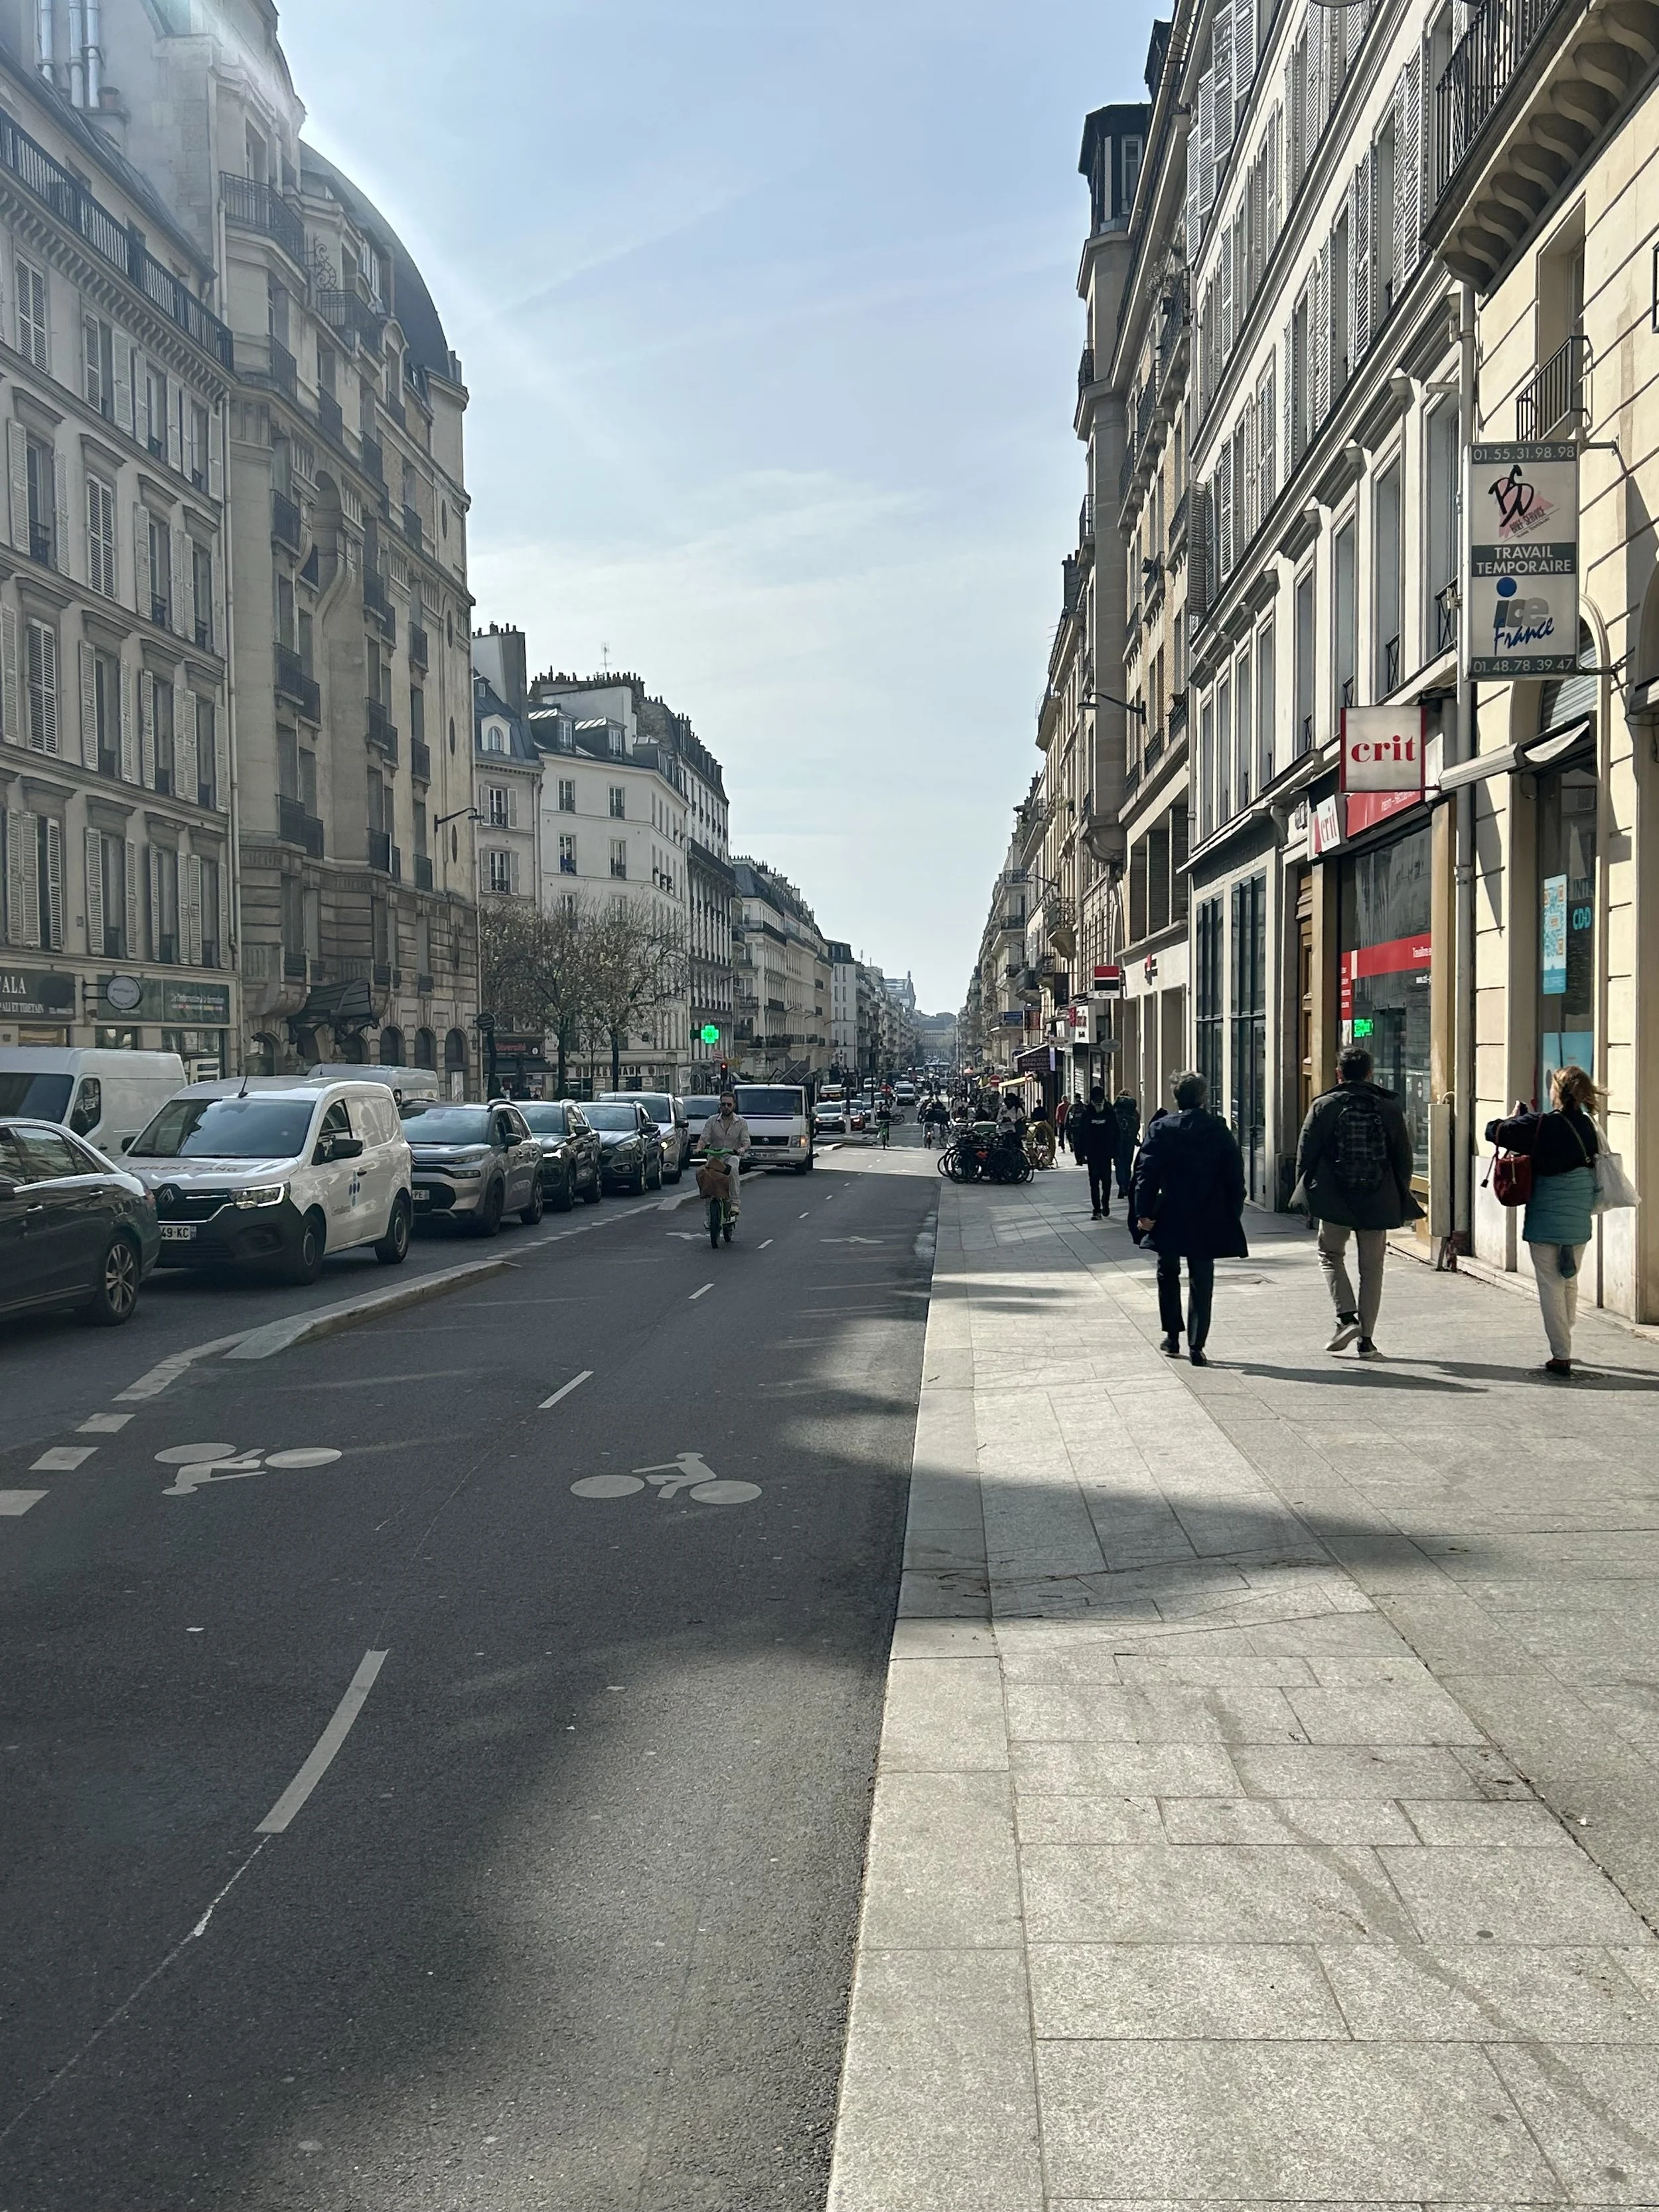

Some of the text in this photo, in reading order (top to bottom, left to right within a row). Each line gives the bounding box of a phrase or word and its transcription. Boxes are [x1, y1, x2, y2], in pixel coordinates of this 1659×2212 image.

[1473, 446, 1575, 461] 01.55.31.98.98
[1494, 546, 1553, 559] TRAVAIL
[1476, 559, 1571, 575] TEMPORAIRE
[1493, 577, 1549, 628] ice
[1494, 617, 1555, 656] France
[1474, 658, 1573, 672] 01.48.78.39.47
[1351, 735, 1416, 763] crit
[1321, 805, 1337, 843] crit
[0, 976, 27, 994] ALA
